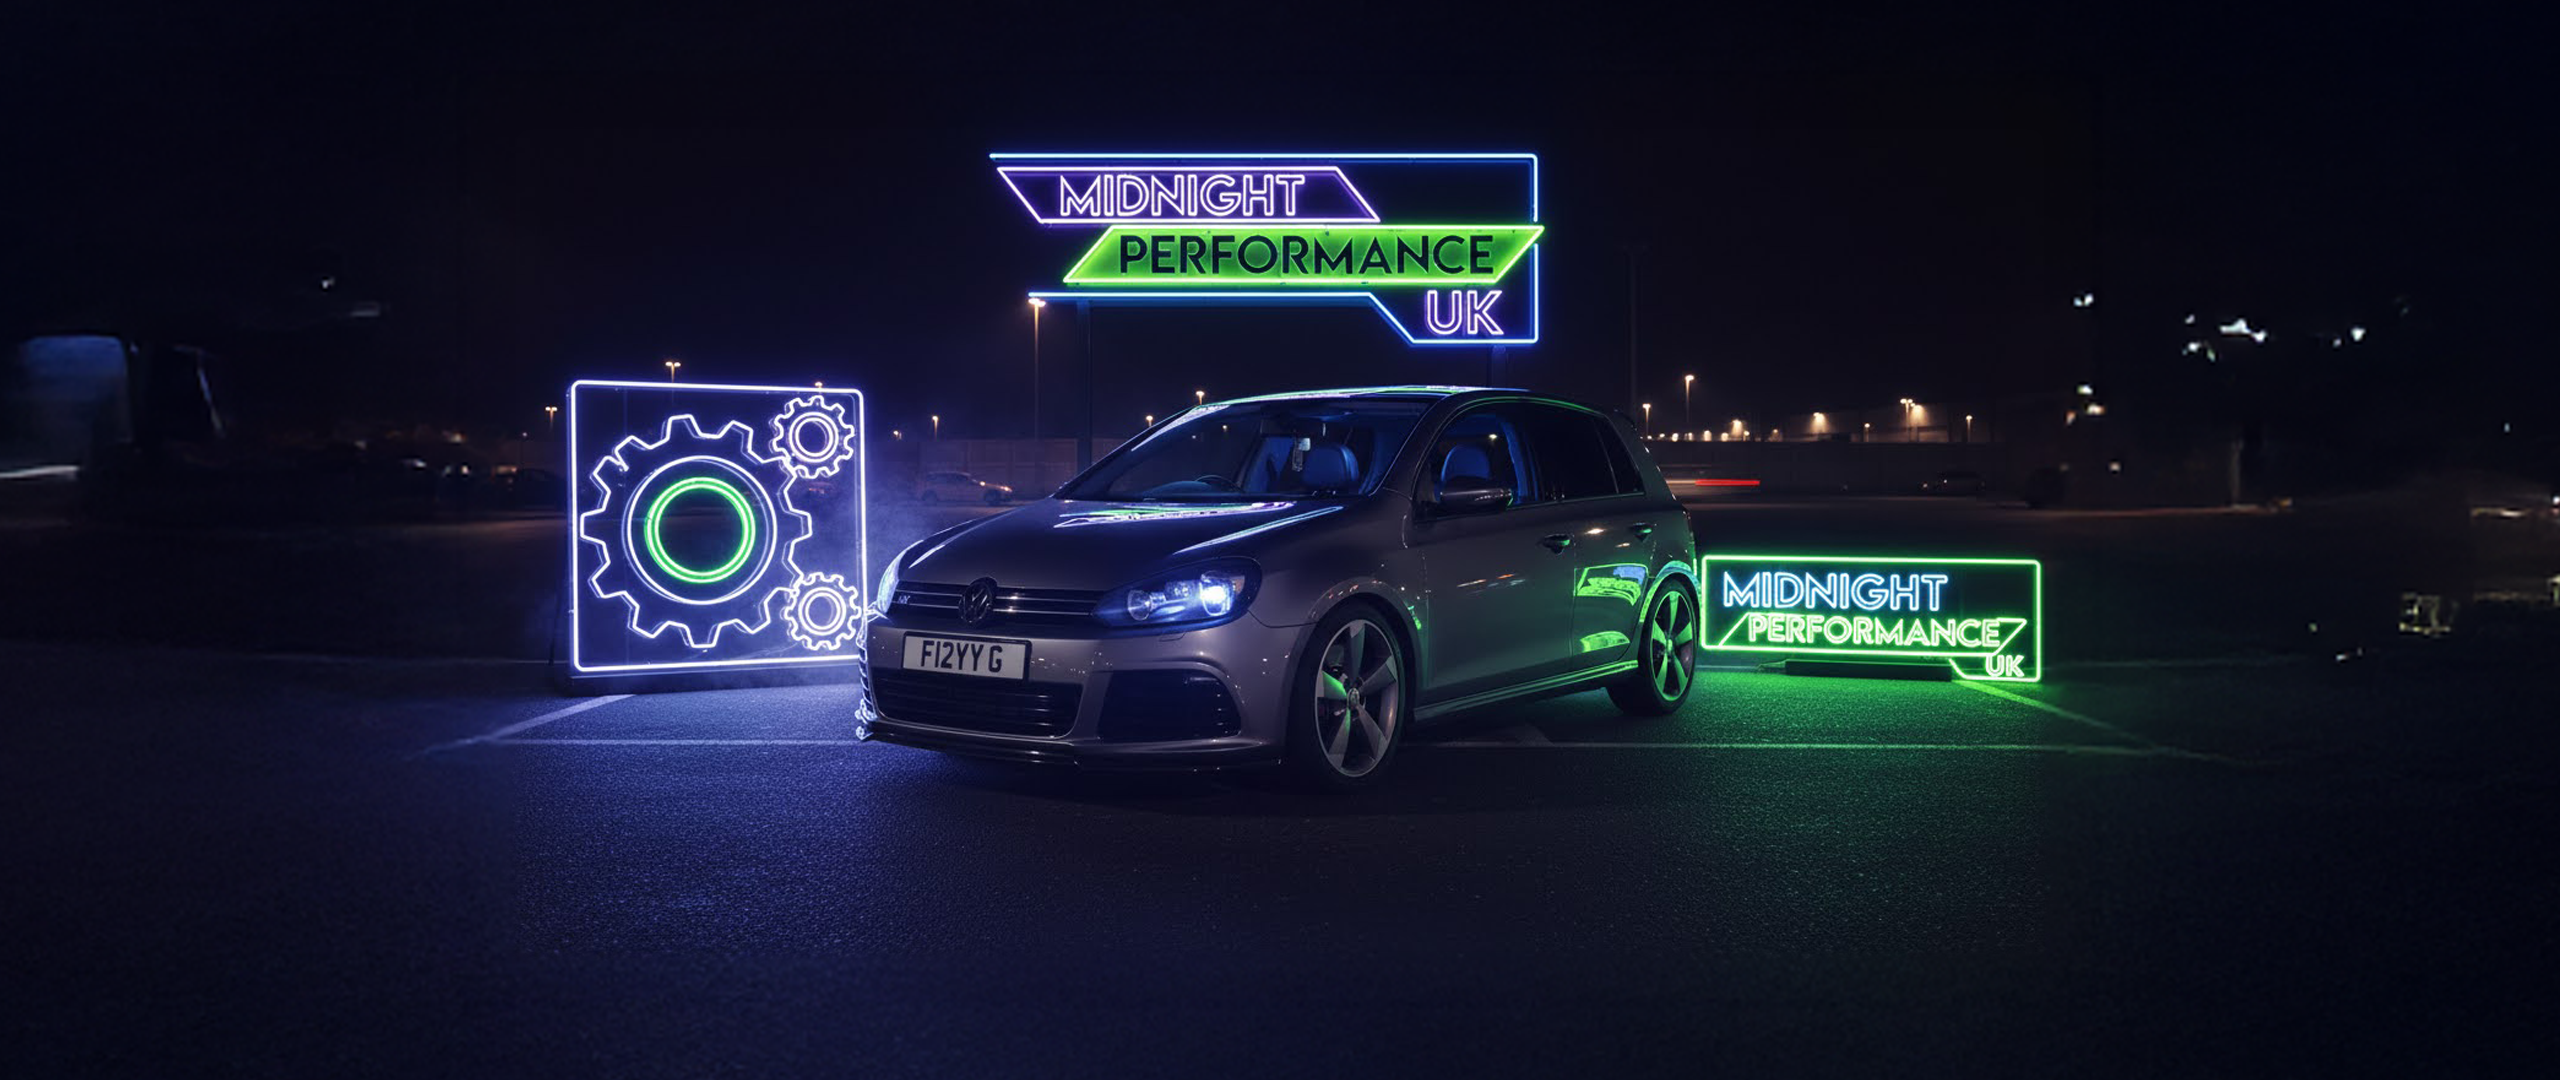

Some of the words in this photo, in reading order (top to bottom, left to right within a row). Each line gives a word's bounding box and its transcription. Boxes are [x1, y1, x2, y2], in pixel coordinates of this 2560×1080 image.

[1059, 174, 1305, 216] MIDNIGHT
[1120, 235, 1493, 275] PERFORMANCE
[1426, 290, 1503, 335] UK
[1722, 571, 1948, 611] MIDNIGHT
[1748, 613, 2000, 647] PERFORMANCE
[988, 645, 1003, 672] G
[1985, 655, 2025, 677] UK
